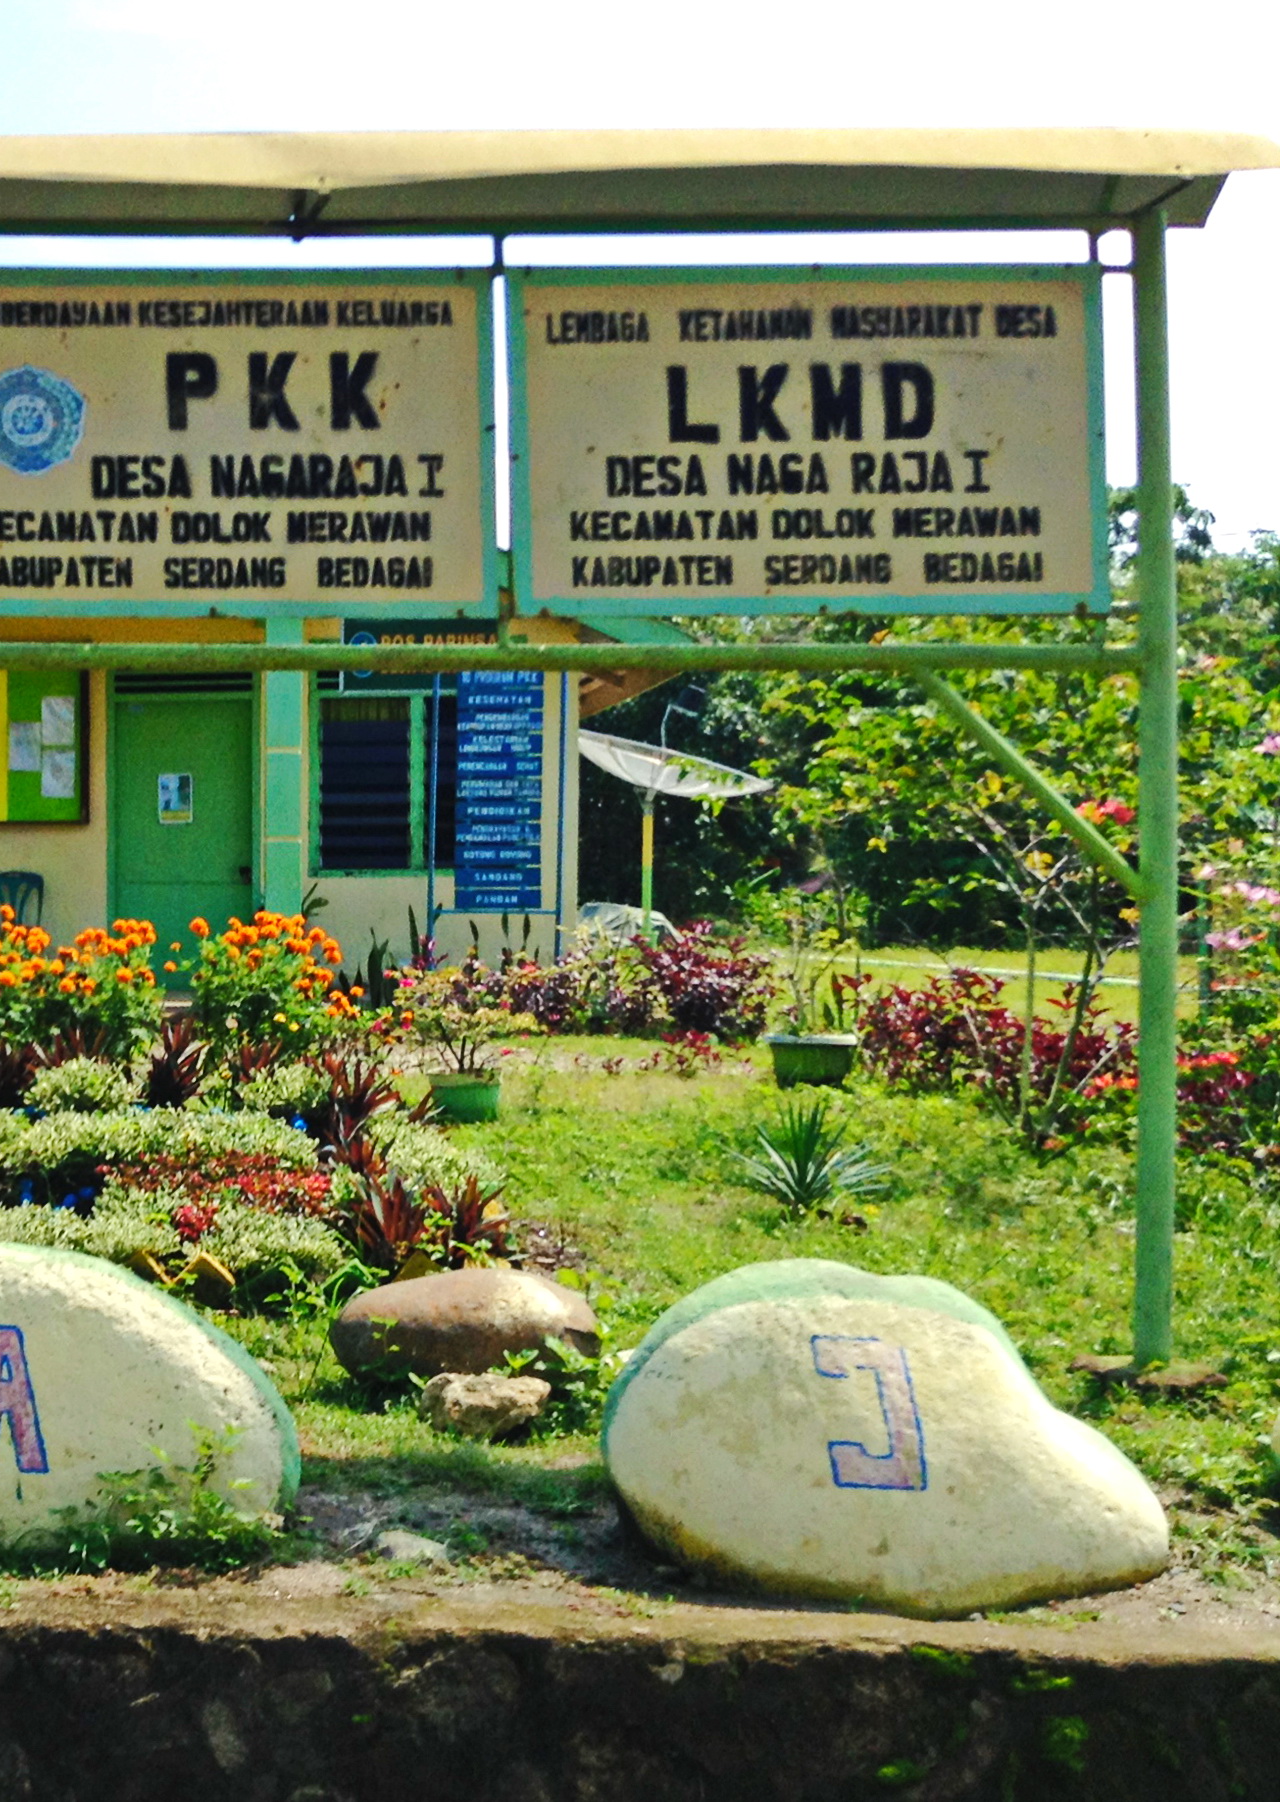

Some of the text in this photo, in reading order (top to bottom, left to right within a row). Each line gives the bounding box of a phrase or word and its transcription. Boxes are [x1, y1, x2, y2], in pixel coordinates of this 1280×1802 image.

[138, 301, 328, 327] KESEJAHTERAAN
[337, 302, 453, 327] KELUARGA
[546, 311, 650, 344] LEMBAGA
[831, 304, 982, 339] MASYARAKAT
[994, 304, 1058, 338] DESA
[666, 361, 936, 444] LKMD
[91, 454, 192, 500] DESA
[418, 454, 444, 498] I
[606, 450, 991, 498] DESA NAGA RAJA I
[171, 511, 271, 544] DOLOK
[287, 511, 431, 543] MERAWAN
[570, 506, 1041, 541] KECAMATAN DOLOK MERAWAN
[164, 557, 287, 589] SERDANG
[317, 556, 433, 589] BEDAGAI
[572, 552, 1043, 587] KABUPATEN SERDANG BEDAGAI
[811, 1335, 928, 1492] J
